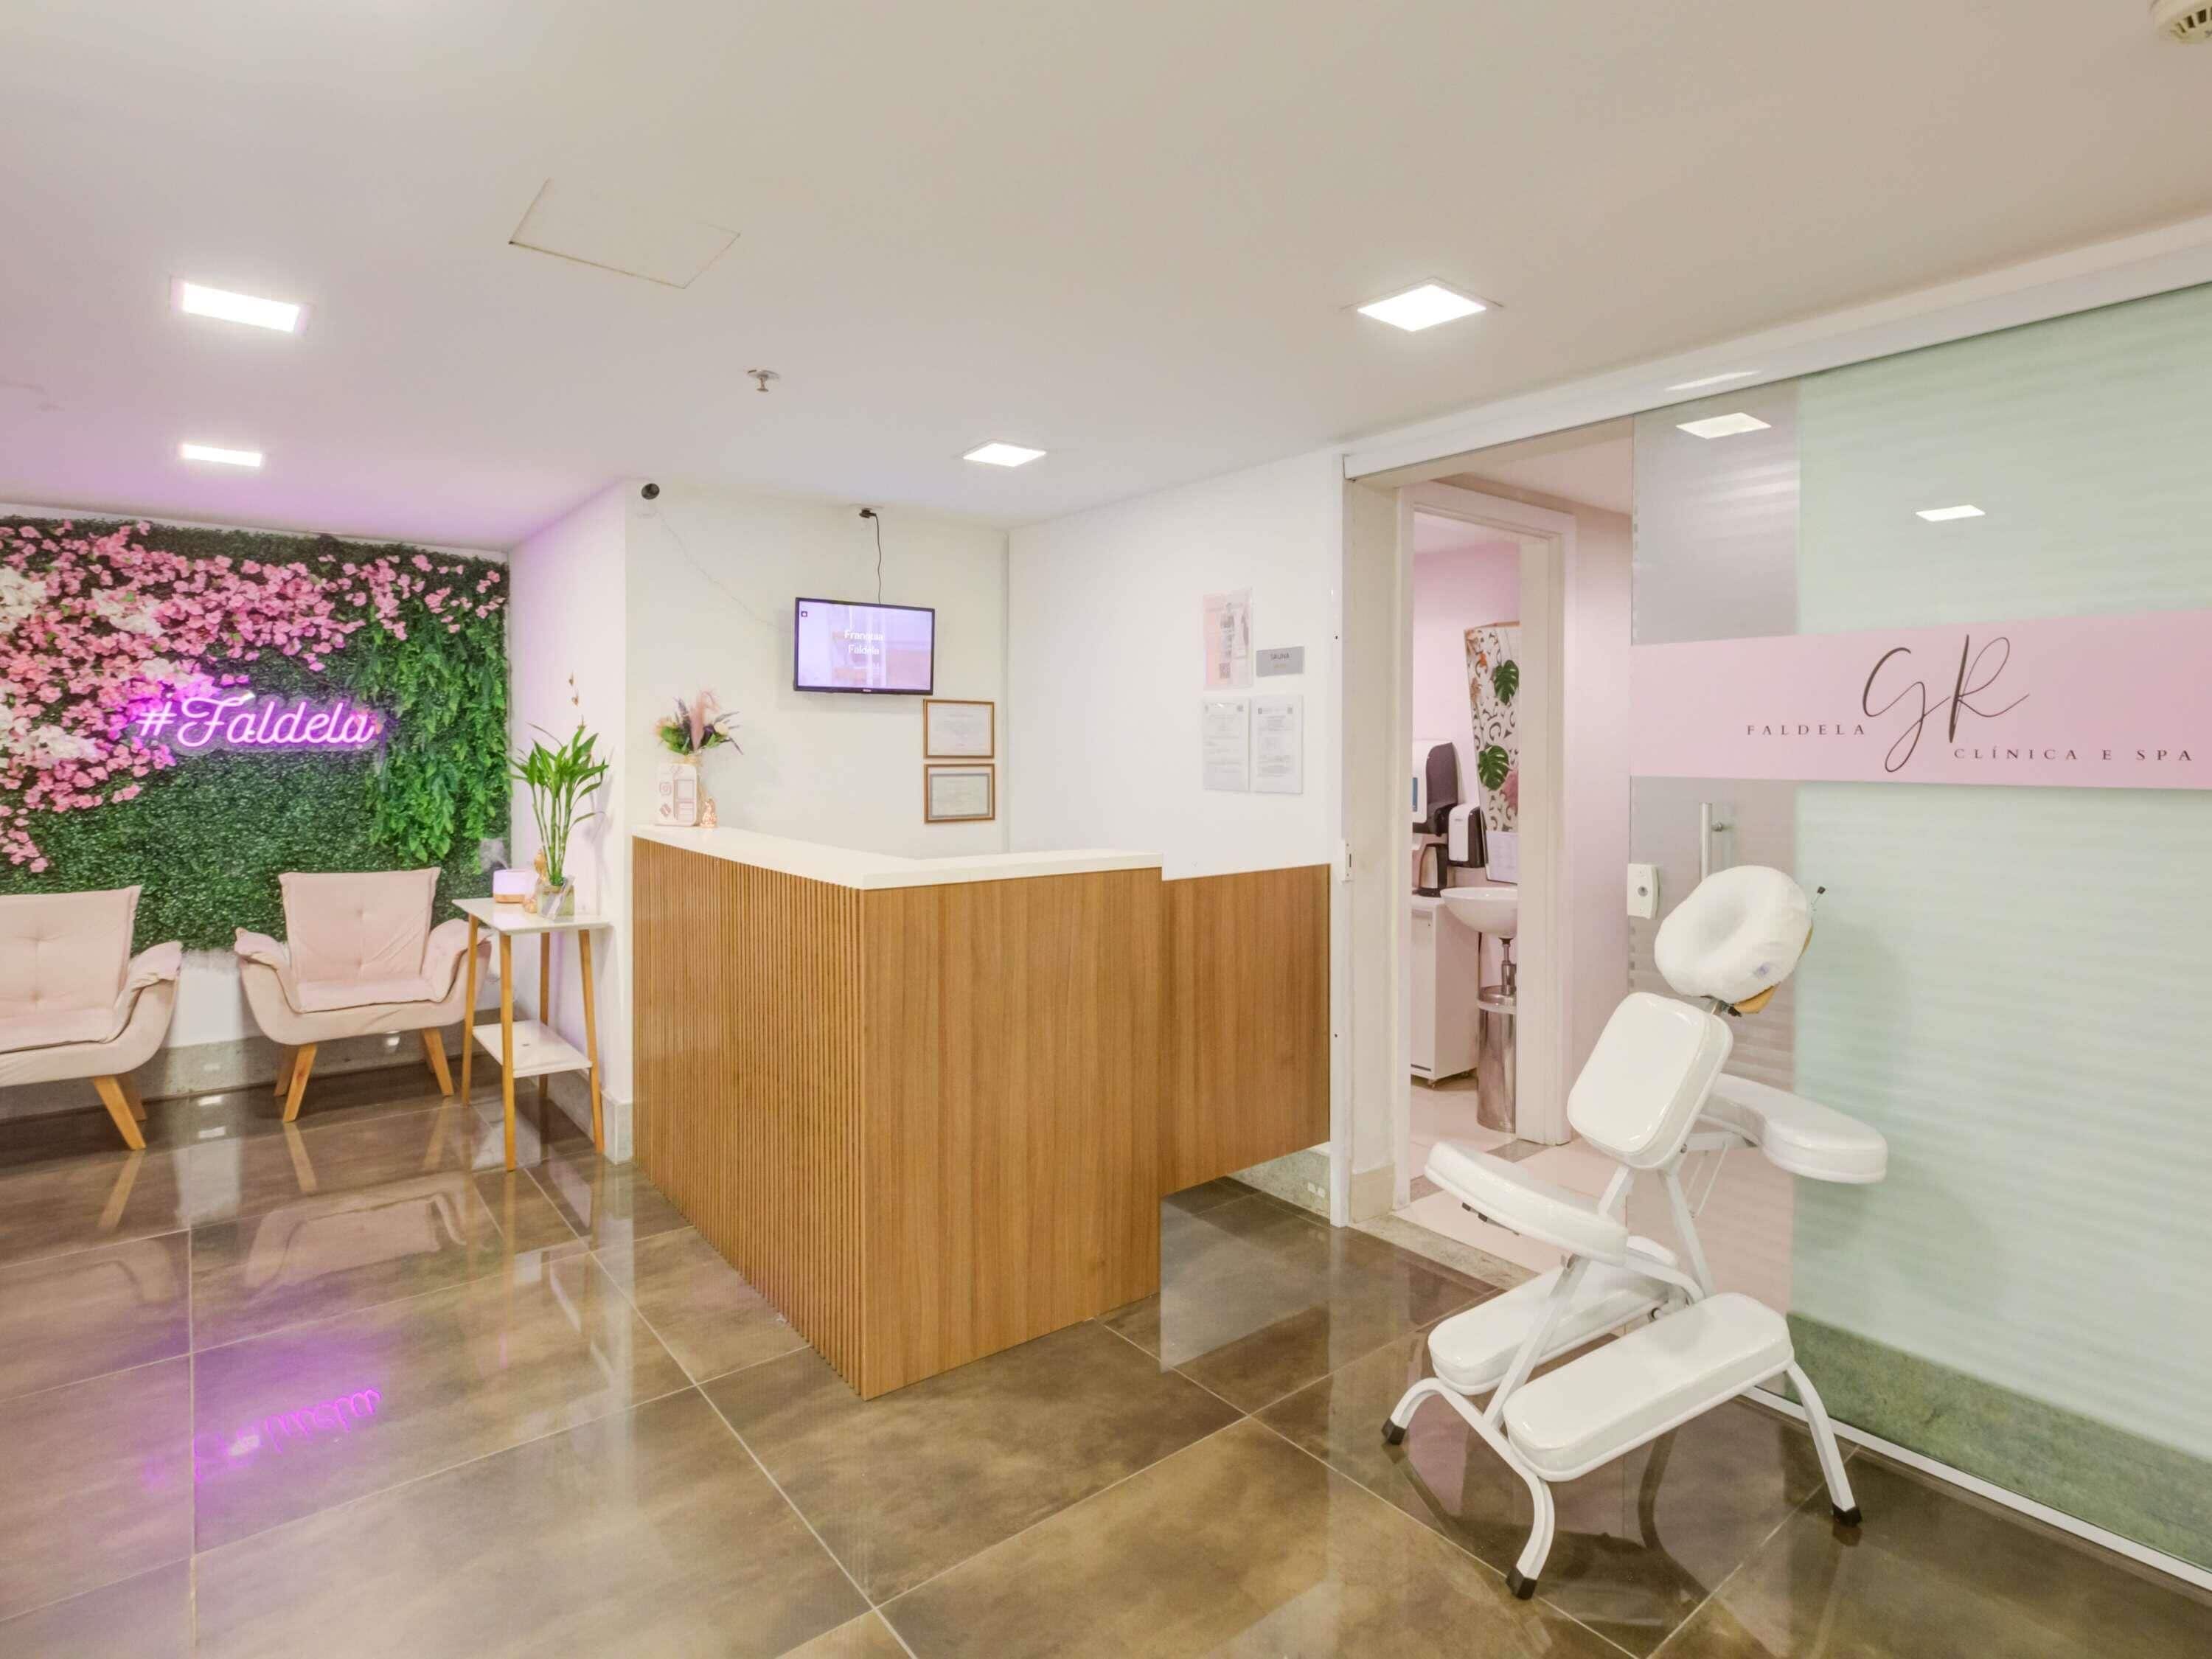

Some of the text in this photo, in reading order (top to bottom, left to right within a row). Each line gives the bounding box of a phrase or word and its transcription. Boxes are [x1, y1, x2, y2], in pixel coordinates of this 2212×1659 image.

[136, 693, 375, 748] #Faldela
[1747, 724, 1865, 736] FALDELA
[1954, 745, 2192, 761] CLÍNICA E SPA
